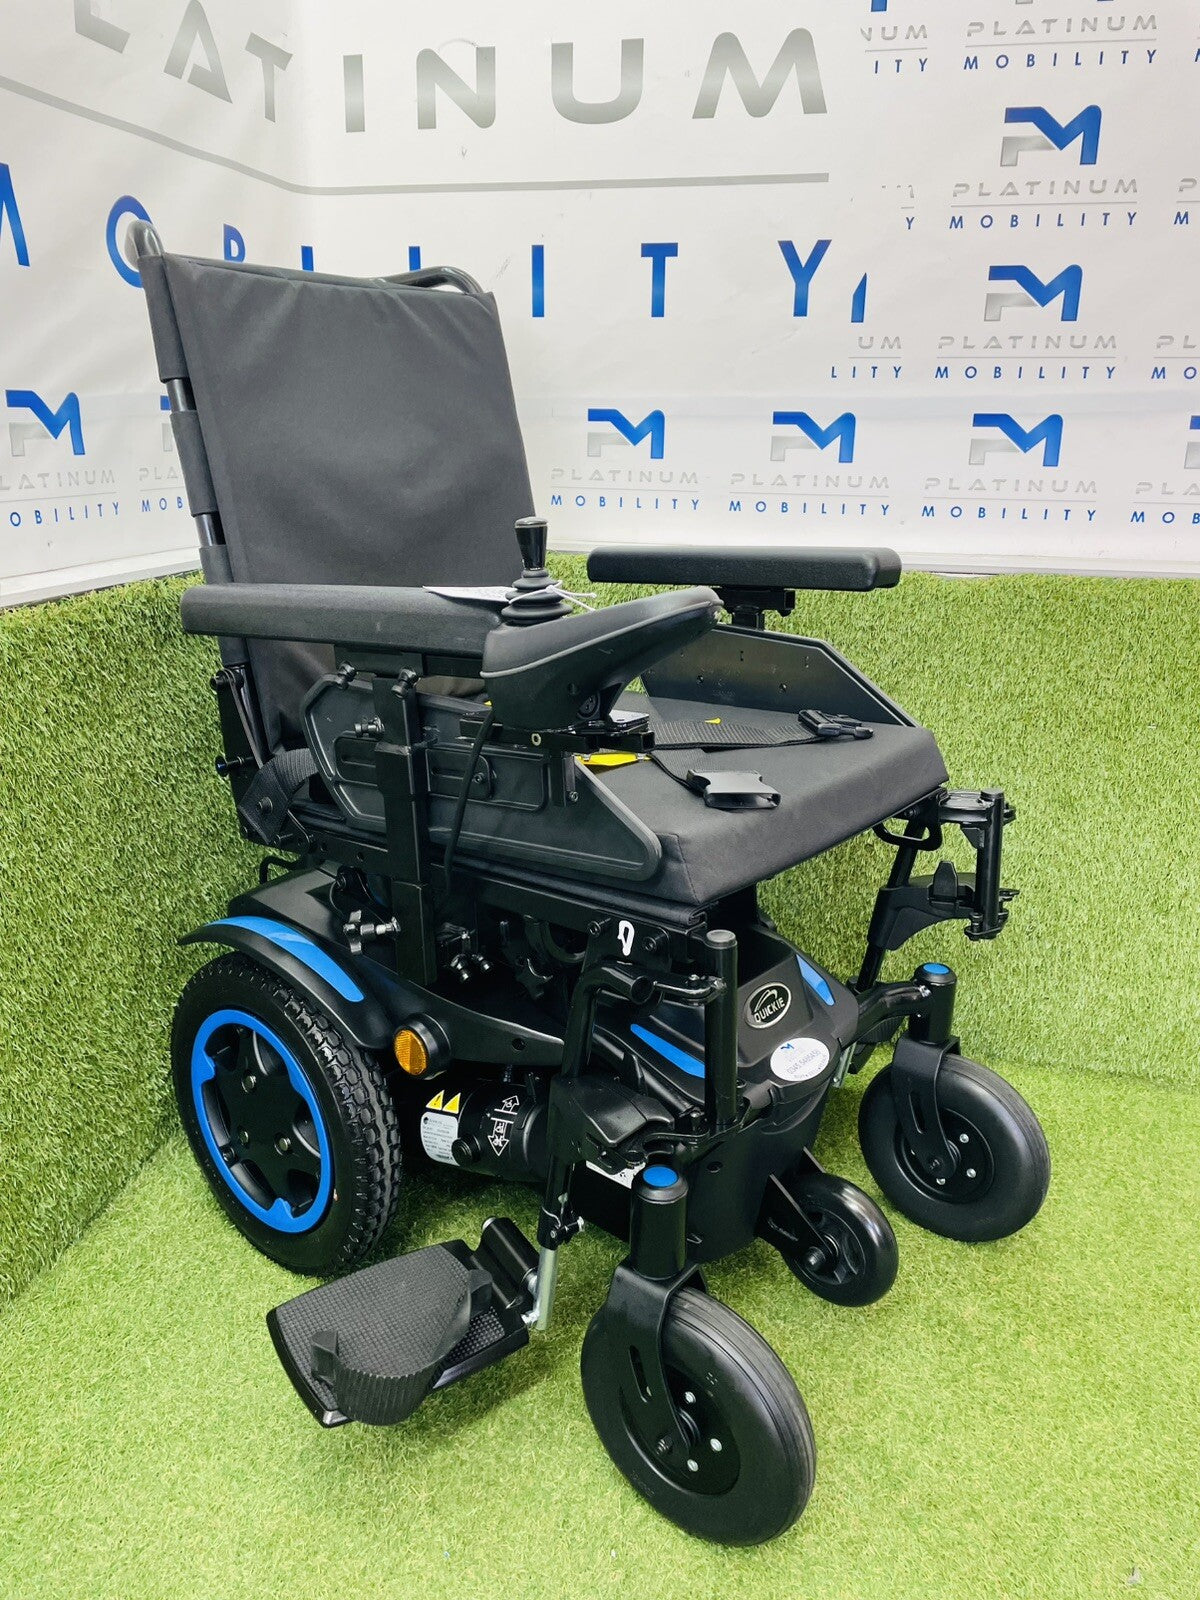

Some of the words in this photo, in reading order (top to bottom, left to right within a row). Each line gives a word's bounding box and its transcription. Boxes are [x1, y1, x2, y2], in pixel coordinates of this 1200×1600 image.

[967, 15, 1157, 37] PLATINUM
[964, 50, 1157, 70] MOBILITY
[953, 179, 1138, 197] PLATINUM
[949, 212, 1137, 229] MOBILITY
[938, 335, 1117, 349] PLATINUM
[935, 366, 1115, 379] MOBILITY
[551, 468, 698, 484] PLATINUM
[730, 472, 889, 488] PLATINUM
[925, 477, 1097, 494] PLATINUM
[551, 495, 699, 510] MOBILITY
[729, 501, 889, 516] MOBILITY
[922, 505, 1096, 521] MOBILITY
[753, 997, 785, 1023] QUICKIE
